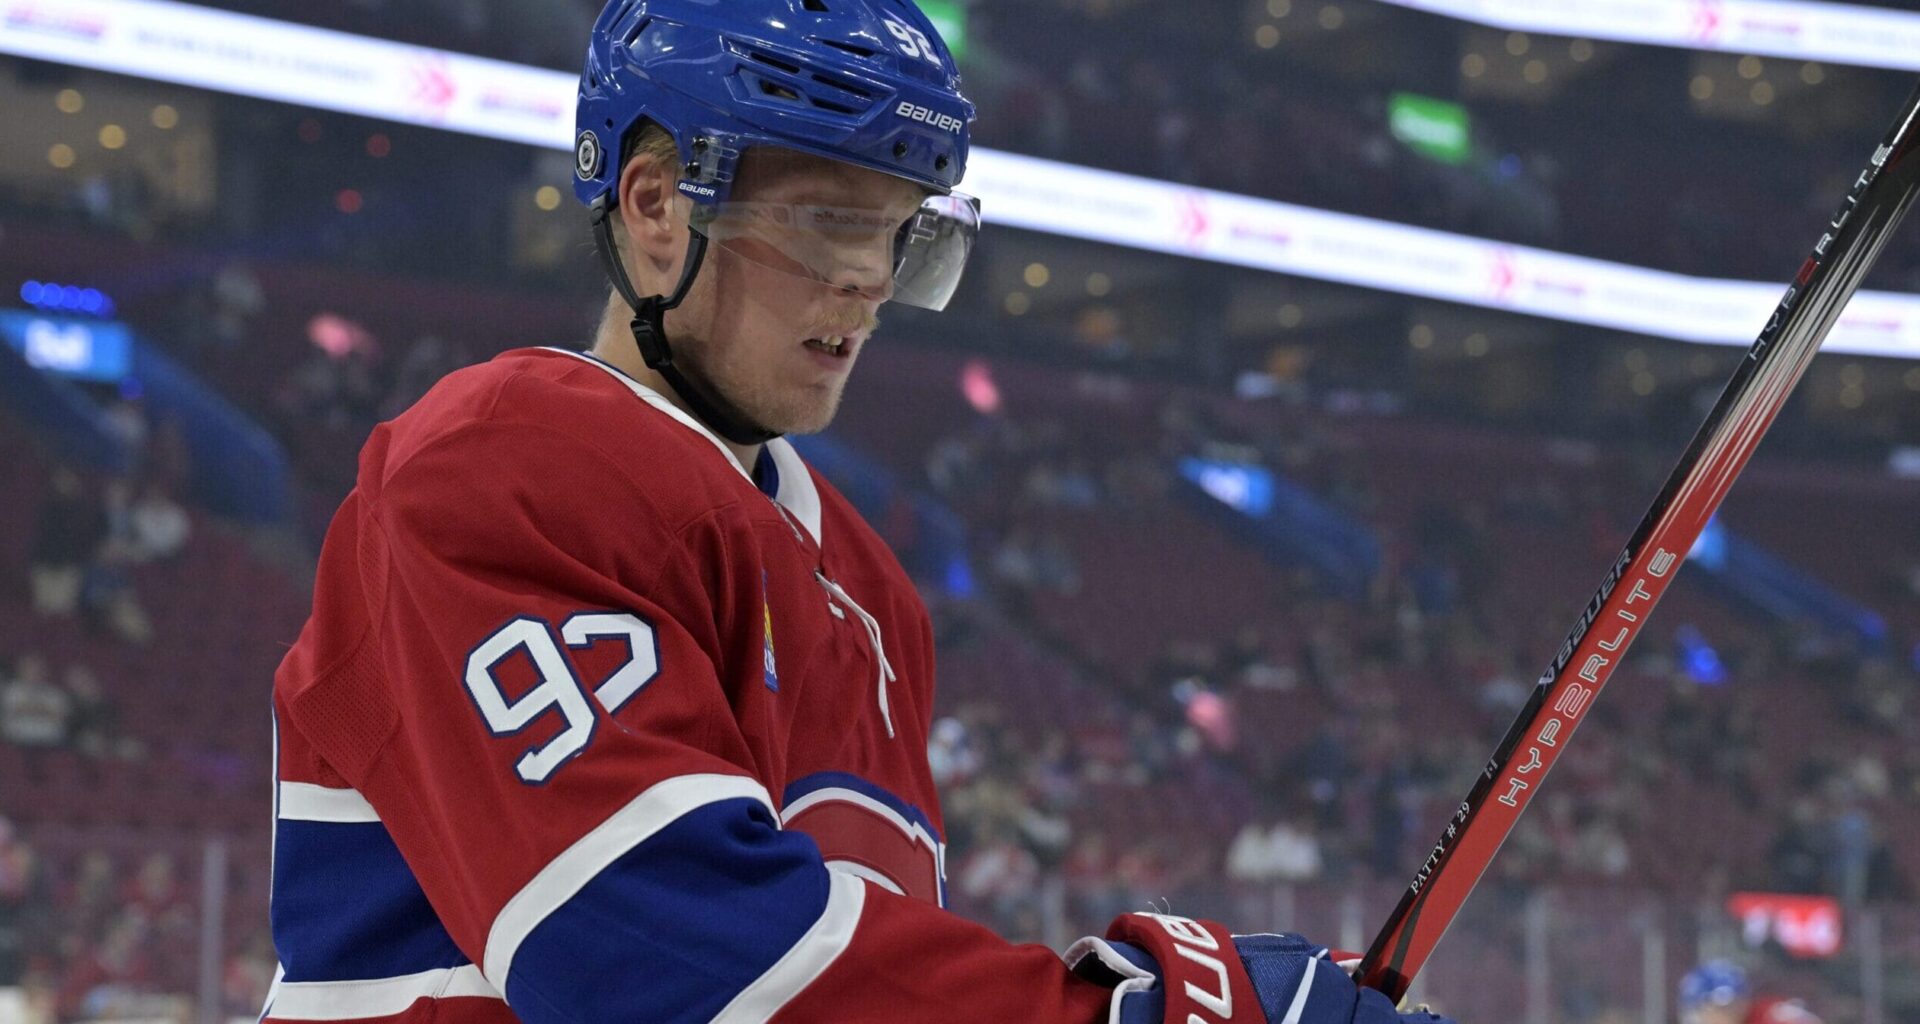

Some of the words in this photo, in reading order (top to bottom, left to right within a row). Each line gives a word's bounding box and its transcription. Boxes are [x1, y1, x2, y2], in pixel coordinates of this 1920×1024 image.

[884, 19, 942, 67] 92
[895, 101, 963, 135] BAUER
[678, 182, 716, 197] BAUER
[463, 610, 661, 785] 92
[1410, 839, 1446, 895] PATTY
[1446, 822, 1457, 839] #
[1456, 801, 1470, 823] 29
